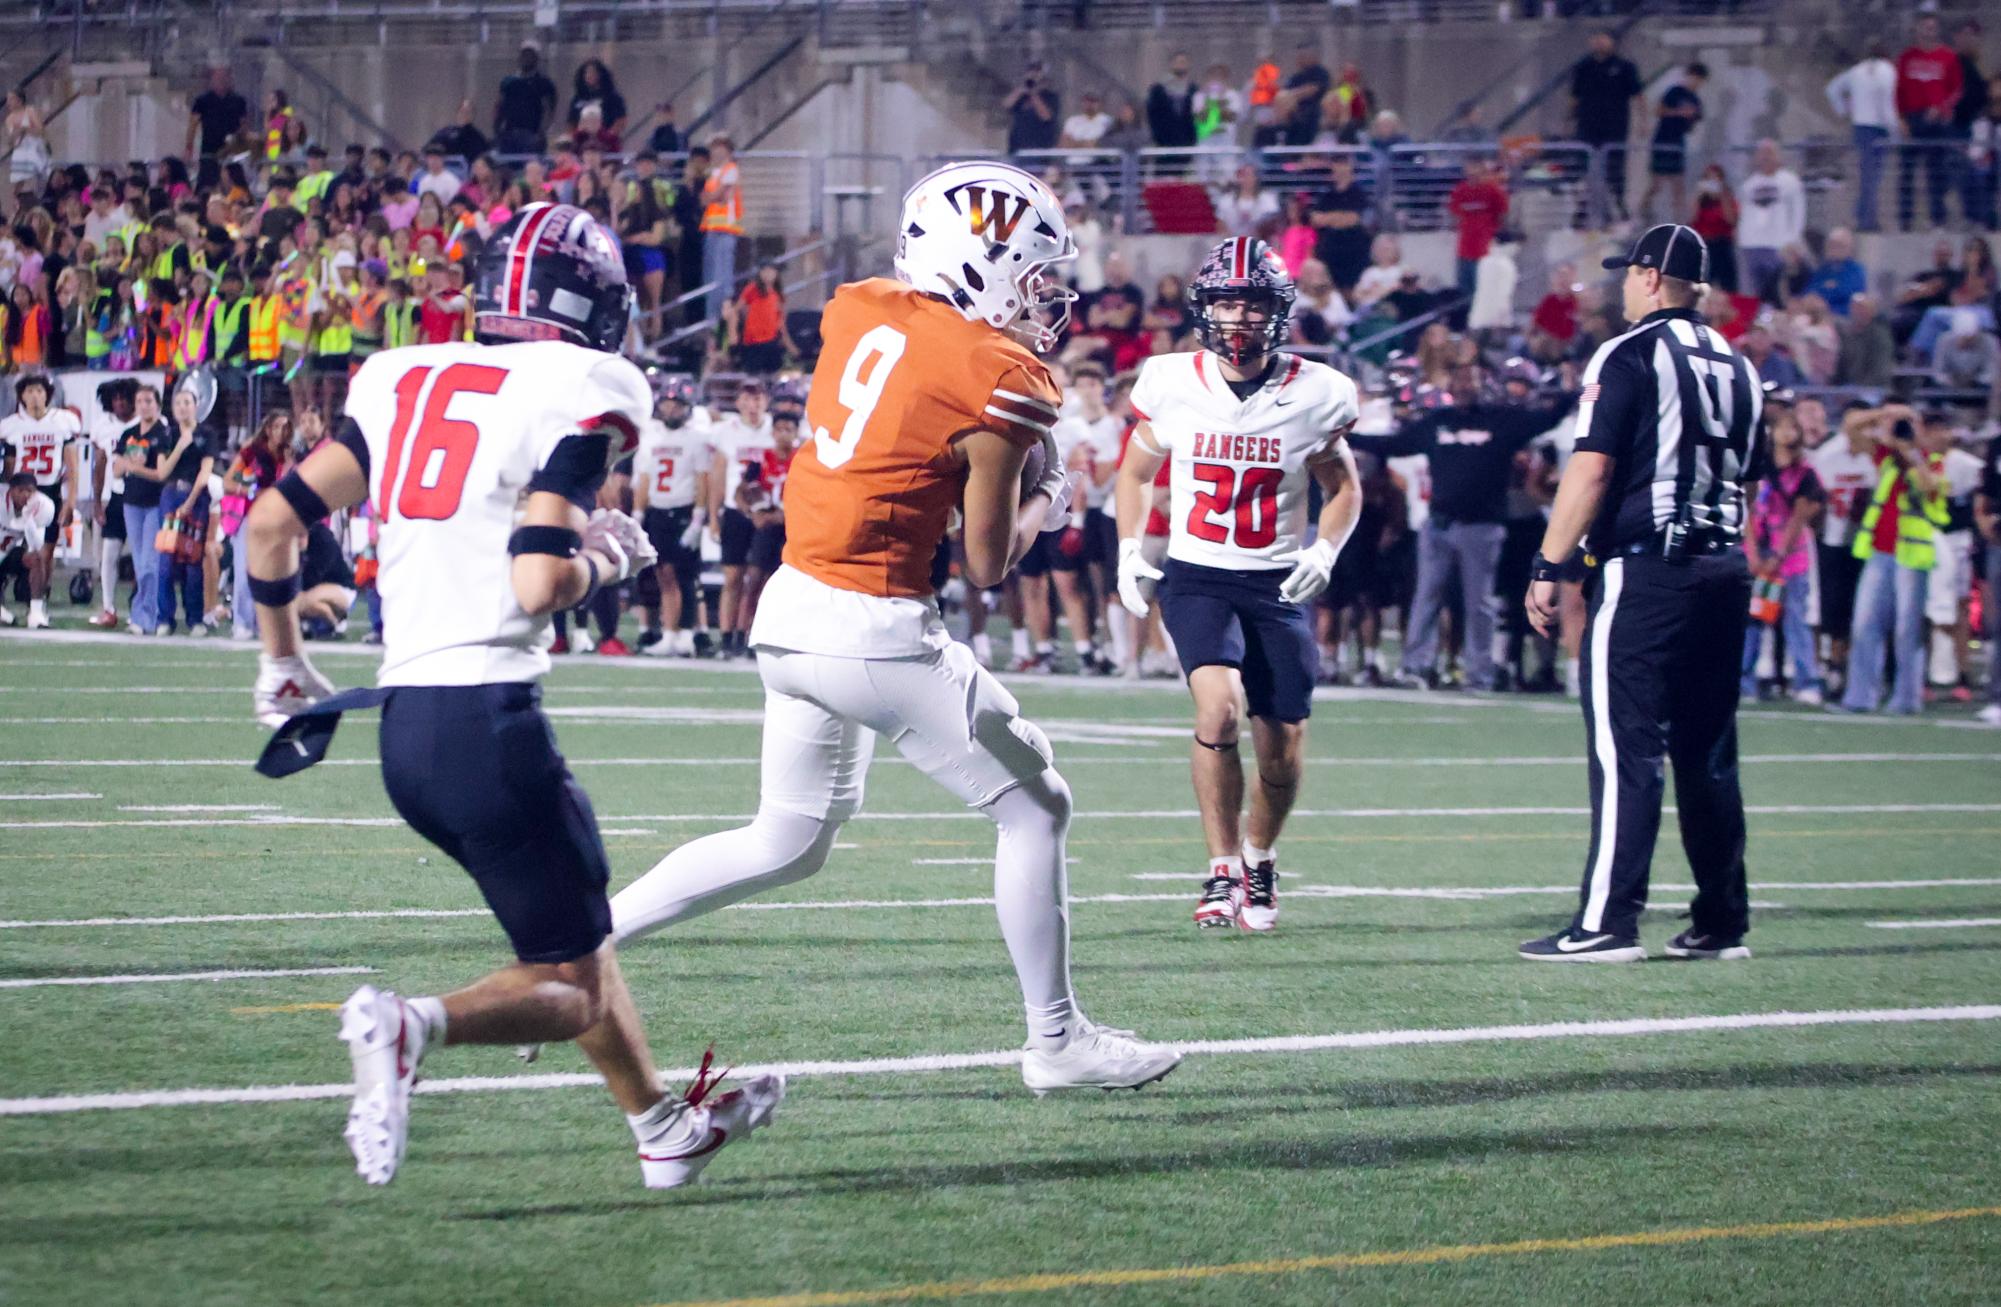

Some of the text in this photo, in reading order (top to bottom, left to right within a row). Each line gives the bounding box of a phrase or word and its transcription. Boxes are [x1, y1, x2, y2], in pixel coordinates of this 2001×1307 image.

[965, 186, 1032, 243] W
[814, 324, 907, 470] 9
[22, 445, 55, 475] 25
[379, 363, 510, 524] 16
[1193, 433, 1281, 463] RANGERS
[656, 458, 674, 493] 2
[1187, 463, 1285, 549] 20
